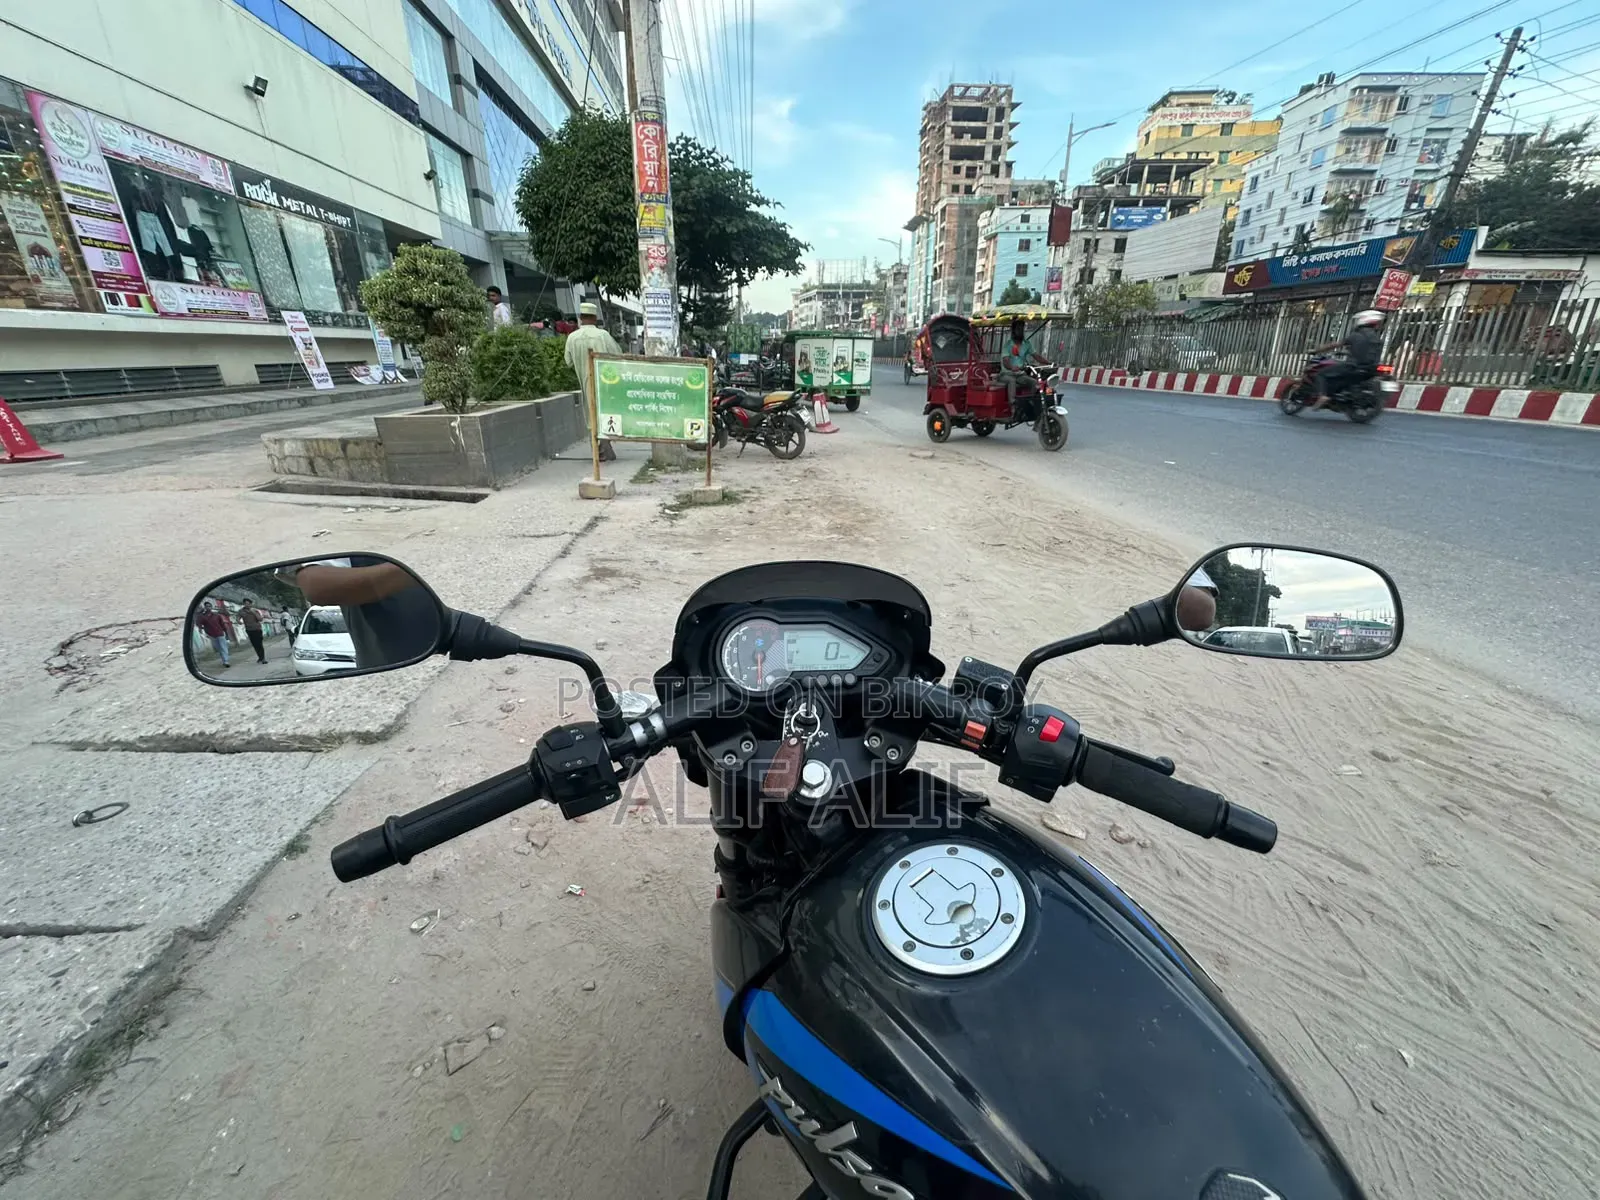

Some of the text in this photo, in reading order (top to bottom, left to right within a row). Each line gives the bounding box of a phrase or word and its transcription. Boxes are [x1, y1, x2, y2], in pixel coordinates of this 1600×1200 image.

[120, 124, 200, 160] SUGLOW
[50, 154, 104, 176] SUGLOW
[281, 196, 318, 218] METAL
[319, 208, 352, 227] T-SHIRT
[1282, 243, 1368, 268] মিষ্টি ও কনফেকশনারি
[179, 285, 242, 299] SUGLOW
[824, 641, 840, 660] 0
